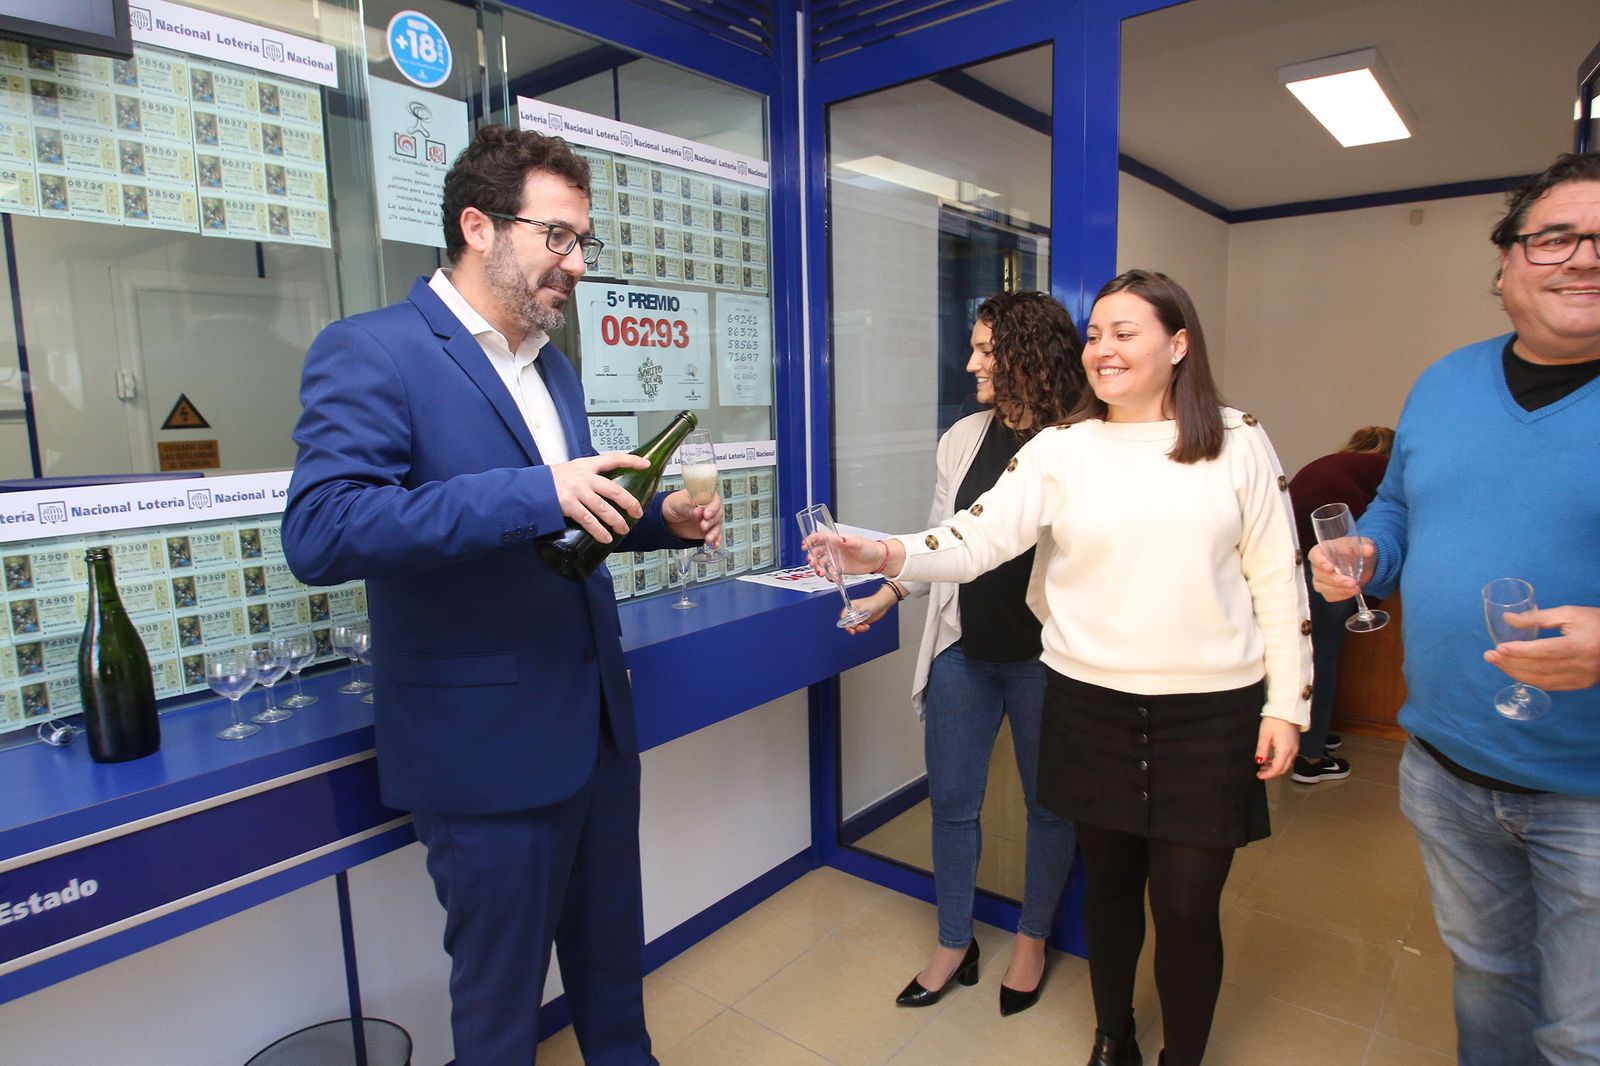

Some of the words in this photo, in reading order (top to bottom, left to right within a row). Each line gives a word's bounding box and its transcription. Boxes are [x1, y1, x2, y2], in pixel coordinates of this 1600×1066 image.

[156, 18, 211, 41] Nacional
[287, 51, 334, 71] Nacional
[395, 29, 437, 63] +18
[564, 121, 594, 136] Nacional
[634, 138, 660, 151] Nacional
[694, 154, 717, 165] Nacional
[747, 167, 768, 178] Nacional
[628, 292, 680, 312] PREMIO
[728, 314, 758, 325] 69241
[601, 315, 690, 349] 06293
[728, 327, 758, 338] 86372
[728, 339, 759, 350] 58563
[728, 352, 759, 362] 71697
[591, 419, 615, 428] 9241
[592, 428, 623, 437] 86372
[600, 437, 630, 445] 58563
[756, 449, 775, 457] Nacional
[71, 501, 132, 517] Nacional
[215, 489, 266, 504] Nacional
[49, 677, 77, 689] 7490
[0, 878, 98, 926] Estado
